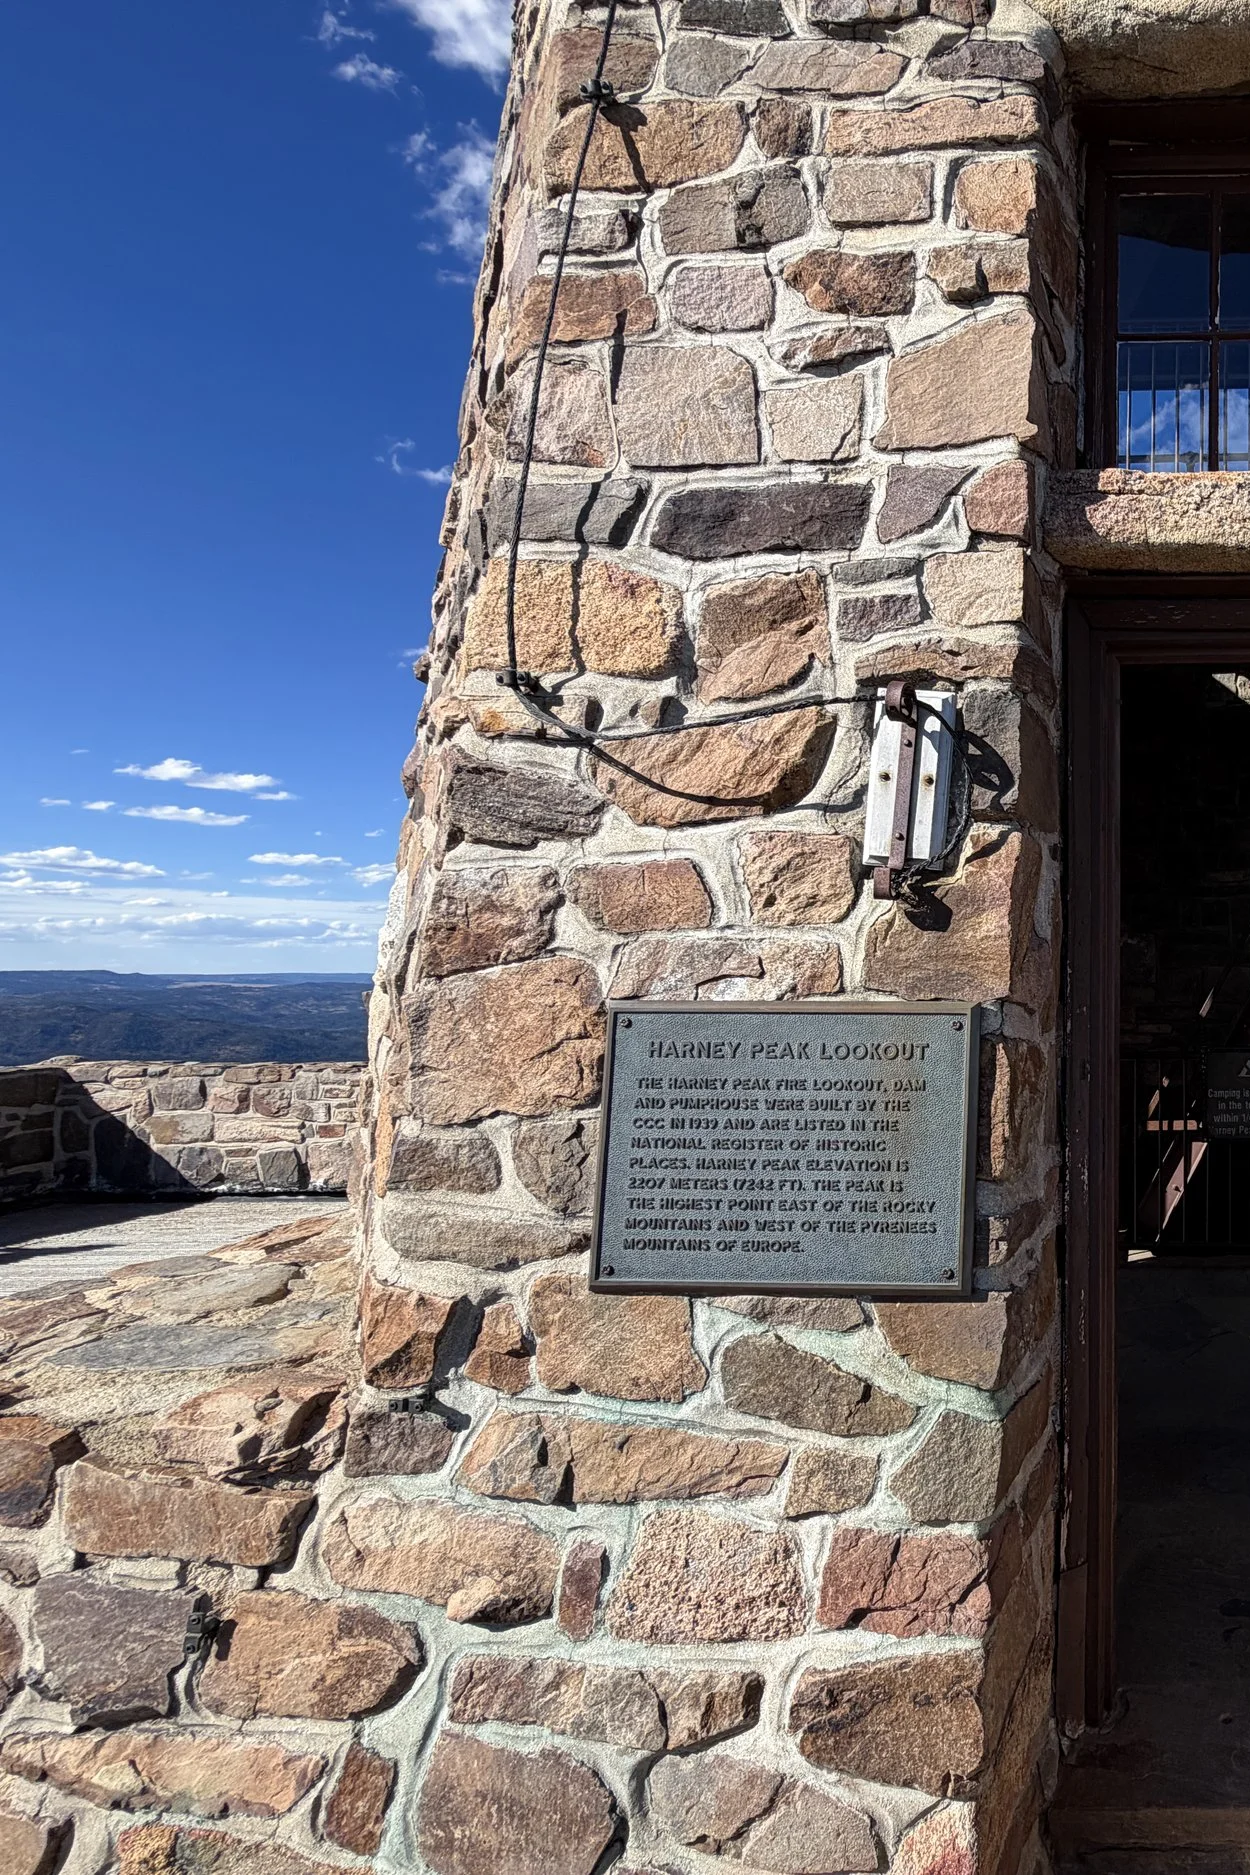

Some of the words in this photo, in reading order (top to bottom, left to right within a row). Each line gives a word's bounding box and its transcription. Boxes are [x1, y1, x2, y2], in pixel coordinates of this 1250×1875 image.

[649, 1041, 741, 1059] HARNEY
[751, 1041, 811, 1060] PEAK
[819, 1042, 930, 1060] LOOKOUT
[637, 1078, 663, 1089] THE
[668, 1078, 729, 1090] HARNEY
[732, 1078, 770, 1091] PEAK
[776, 1079, 807, 1091] FIRE
[812, 1079, 888, 1093] LOOKOUT,
[893, 1080, 926, 1092] DAM
[1208, 1089, 1241, 1099] Camping
[1243, 1089, 1249, 1097] is
[634, 1098, 666, 1109] AND
[670, 1098, 759, 1110] PUMPHOUSE
[765, 1098, 804, 1111] WERE
[808, 1099, 851, 1111] BUILT
[856, 1099, 876, 1111] BY
[883, 1100, 911, 1112] THE
[1218, 1101, 1226, 1109] in
[1229, 1101, 1242, 1109] the
[1214, 1113, 1239, 1122] within
[633, 1118, 665, 1129] CCC
[670, 1118, 685, 1129] IN
[689, 1118, 719, 1130] 1939
[723, 1118, 755, 1130] AND
[759, 1118, 790, 1131] ARE
[794, 1119, 845, 1131] LISTED
[850, 1119, 866, 1131] IN
[871, 1120, 899, 1132] THE
[631, 1137, 706, 1150] NATIONAL
[711, 1138, 783, 1151] REGISTER
[789, 1139, 810, 1150] OF
[816, 1139, 887, 1151] HISTORIC
[629, 1158, 691, 1170] PLACES.
[696, 1158, 757, 1170] HARNEY
[762, 1159, 800, 1170] PEAK
[806, 1159, 892, 1172] ELEVATION
[896, 1160, 909, 1172] IS
[627, 1177, 666, 1190] 2207
[670, 1178, 728, 1190] METERS
[733, 1178, 774, 1191] (7242
[778, 1179, 806, 1191] FT).
[812, 1179, 841, 1192] THE
[845, 1180, 885, 1192] PEAK
[890, 1180, 903, 1193] IS
[627, 1198, 655, 1210] THE
[659, 1198, 723, 1211] HIGHEST
[727, 1199, 774, 1211] POINT
[778, 1199, 817, 1212] EAST
[823, 1200, 844, 1212] OF
[850, 1200, 878, 1213] THE
[883, 1201, 936, 1213] ROCKY
[624, 1218, 712, 1230] MOUNTAINS
[717, 1219, 750, 1231] AND
[755, 1220, 795, 1232] WEST
[801, 1220, 822, 1232] OF
[826, 1220, 856, 1233] THE
[860, 1220, 937, 1234] PYRENEES
[623, 1238, 711, 1251] MOUNTAINS
[715, 1239, 737, 1252] OF
[742, 1240, 805, 1253] EUROPE.
